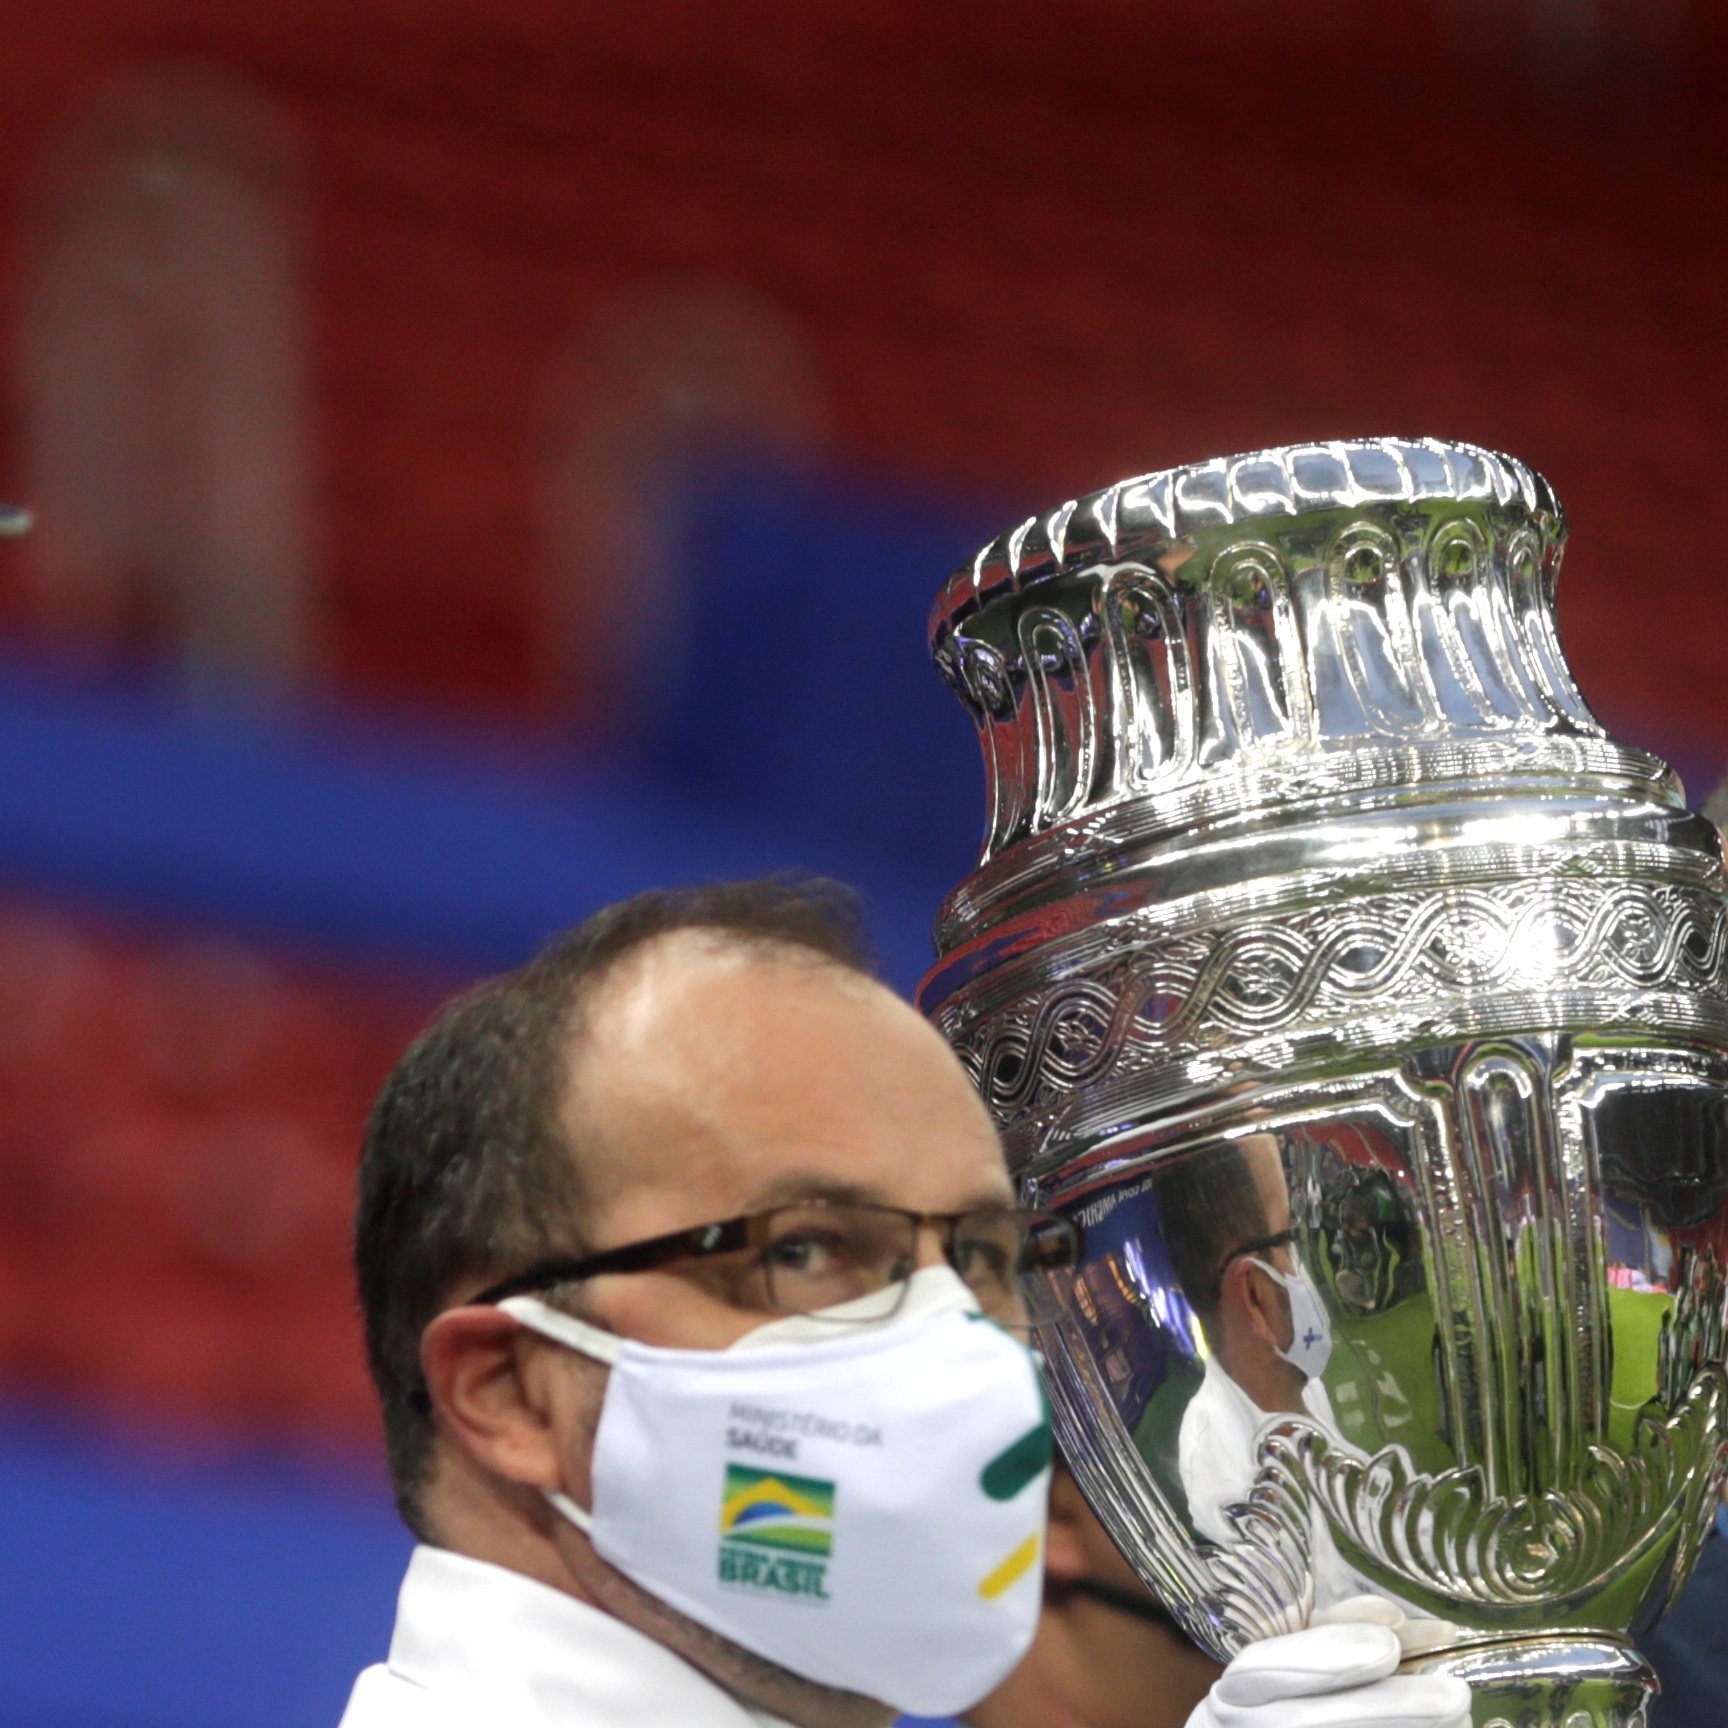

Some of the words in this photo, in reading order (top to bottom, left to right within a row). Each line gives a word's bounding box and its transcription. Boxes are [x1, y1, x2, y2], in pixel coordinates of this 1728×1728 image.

[726, 1427, 798, 1460] SAÚDE
[728, 1402, 848, 1444] MINISTÉRIO
[852, 1423, 883, 1447] DA
[719, 1557, 830, 1599] BRASIL
